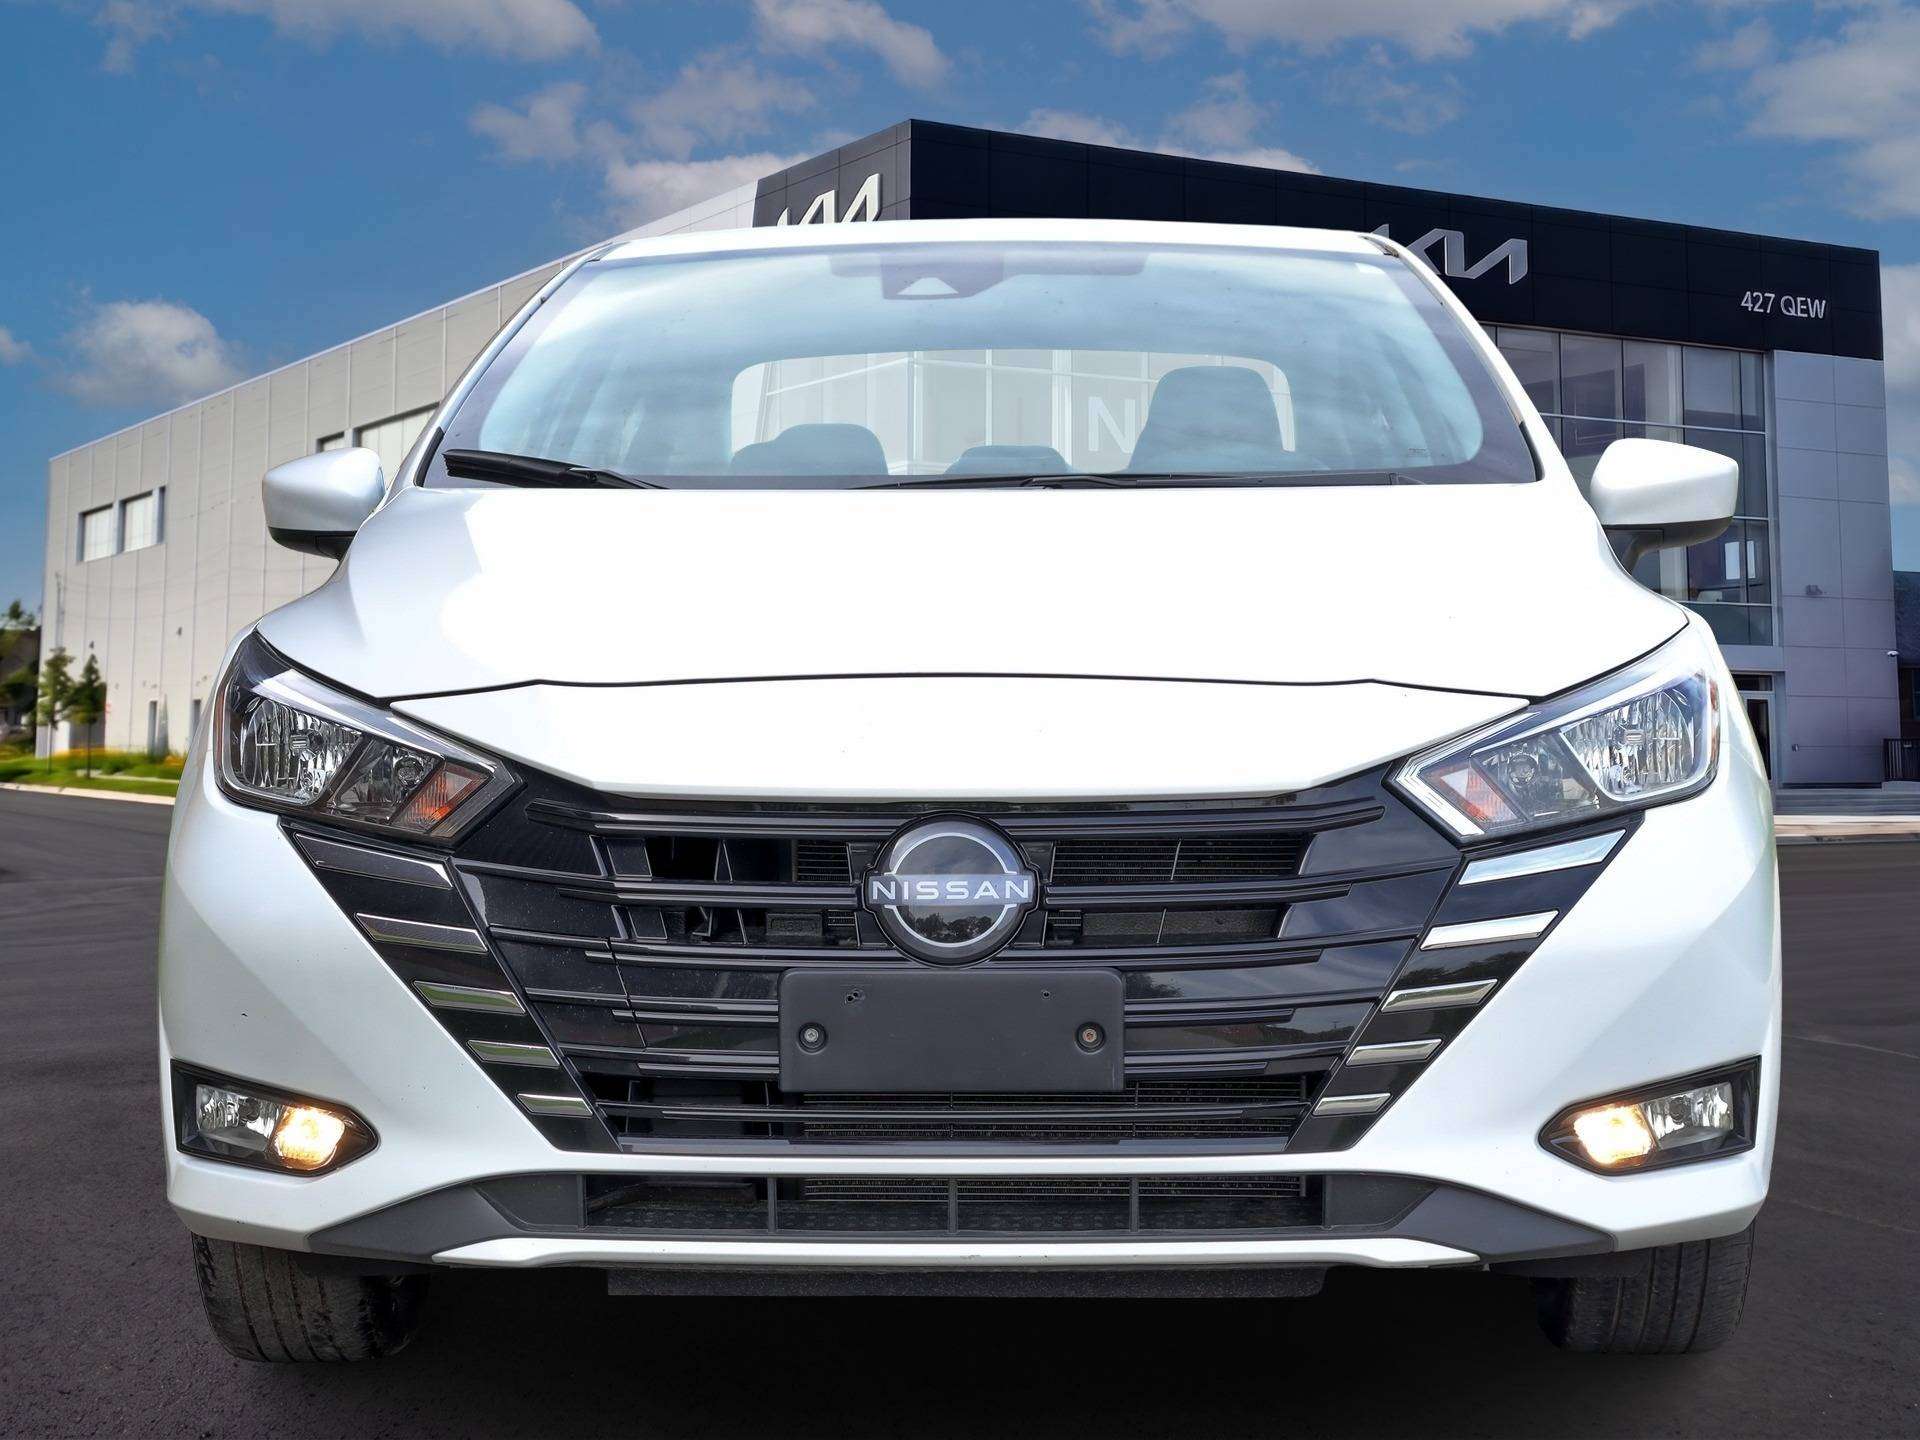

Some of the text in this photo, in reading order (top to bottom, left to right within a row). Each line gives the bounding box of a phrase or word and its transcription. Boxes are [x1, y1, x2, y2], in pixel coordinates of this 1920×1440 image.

[1740, 291, 1826, 319] 427 QEW
[871, 879, 1029, 901] NISSAN
